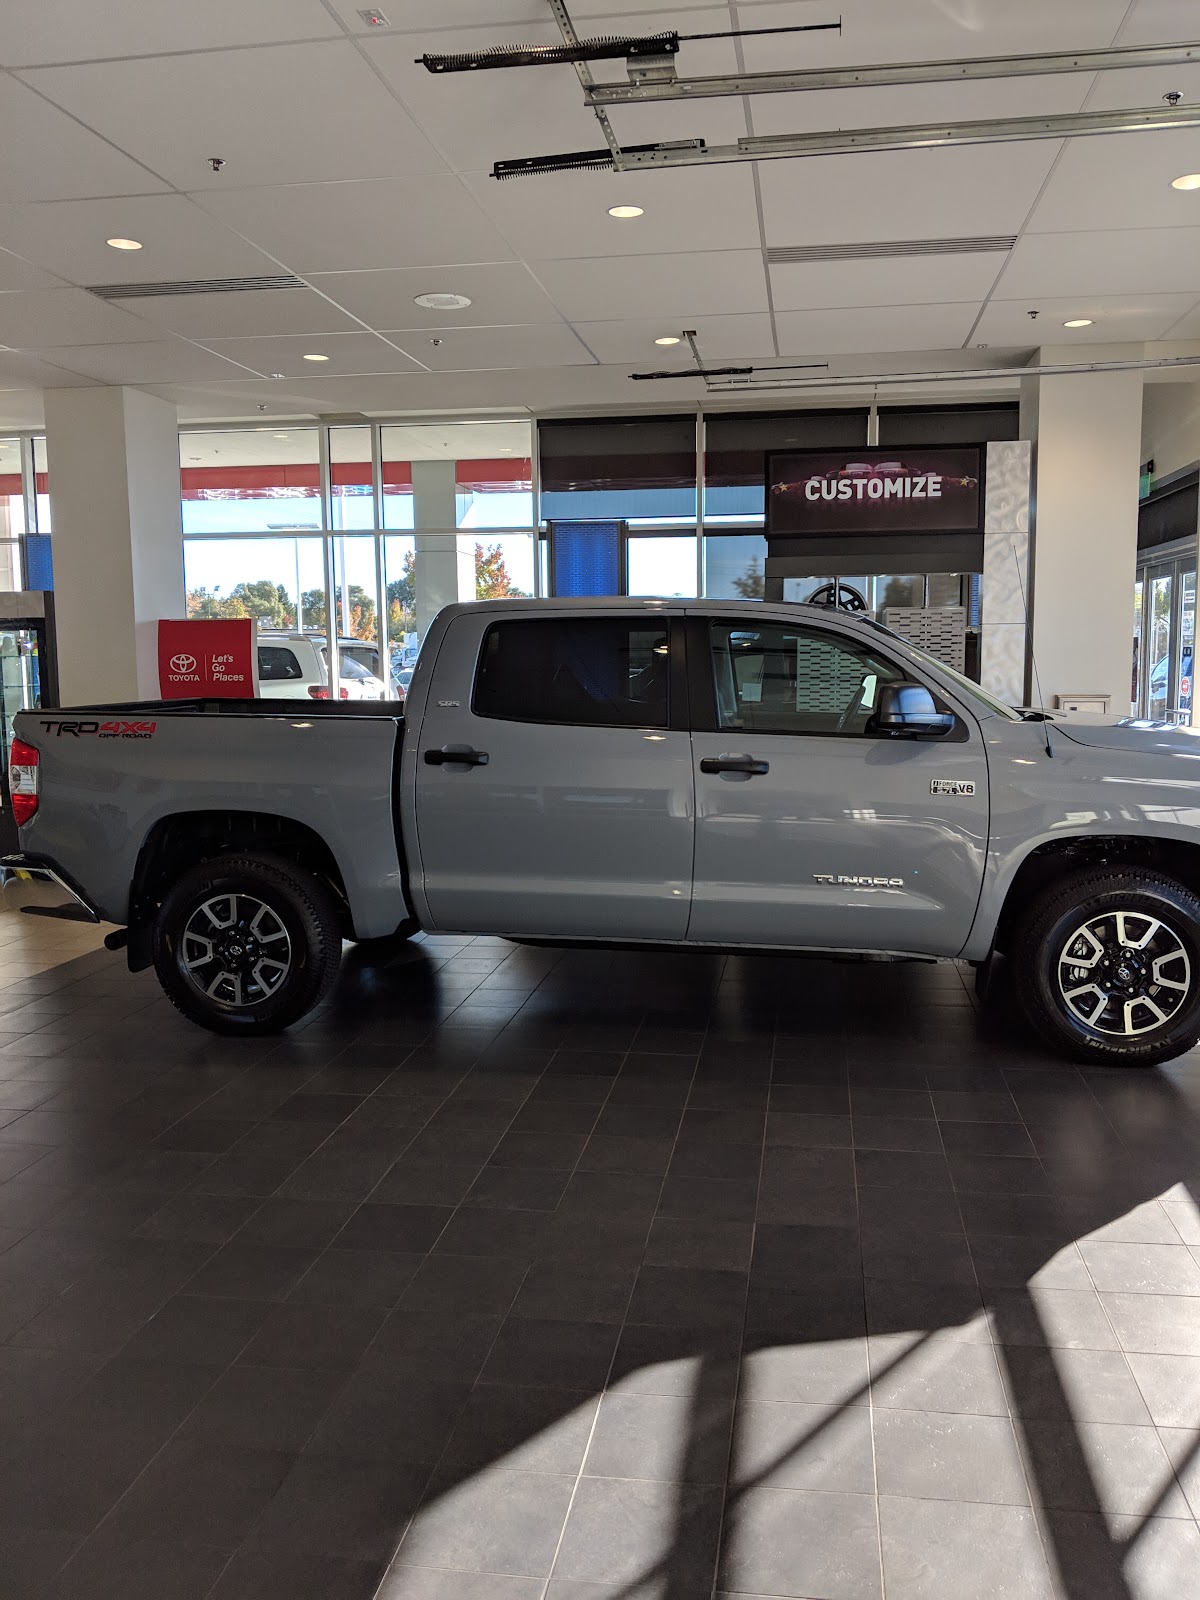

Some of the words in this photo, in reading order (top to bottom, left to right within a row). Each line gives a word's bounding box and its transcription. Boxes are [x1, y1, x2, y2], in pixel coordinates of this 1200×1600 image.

[805, 476, 942, 500] CUSTOMIZE
[212, 654, 234, 663] Let's
[212, 663, 225, 672] Go
[168, 674, 201, 682] TOYOTA
[213, 672, 244, 682] Places
[40, 720, 99, 737] TRD
[812, 874, 904, 888] TUNDRA
